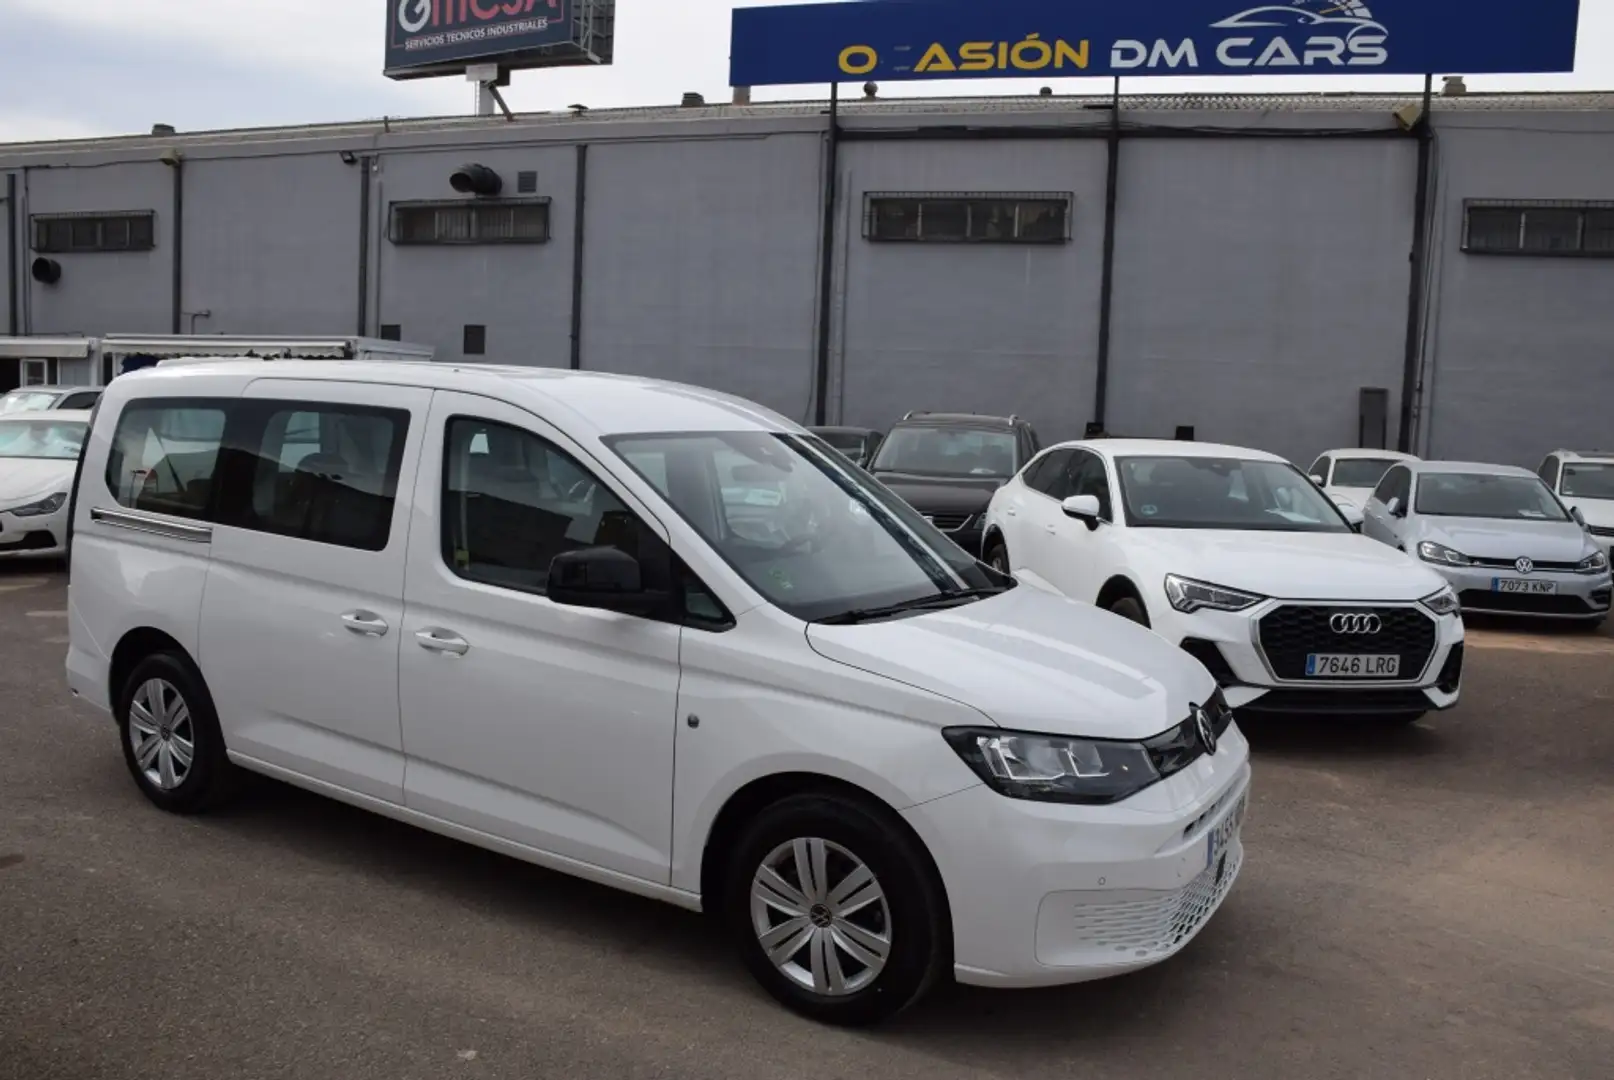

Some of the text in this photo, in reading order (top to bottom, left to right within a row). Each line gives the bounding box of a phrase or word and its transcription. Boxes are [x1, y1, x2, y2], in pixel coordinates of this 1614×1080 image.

[405, 35, 444, 50] SERVICIOS
[487, 18, 548, 36] INDUSTRIALES
[838, 33, 1388, 74] OASIÓN DM CARS
[1501, 580, 1529, 592] 7073
[1319, 656, 1397, 674] 7646 LRG
